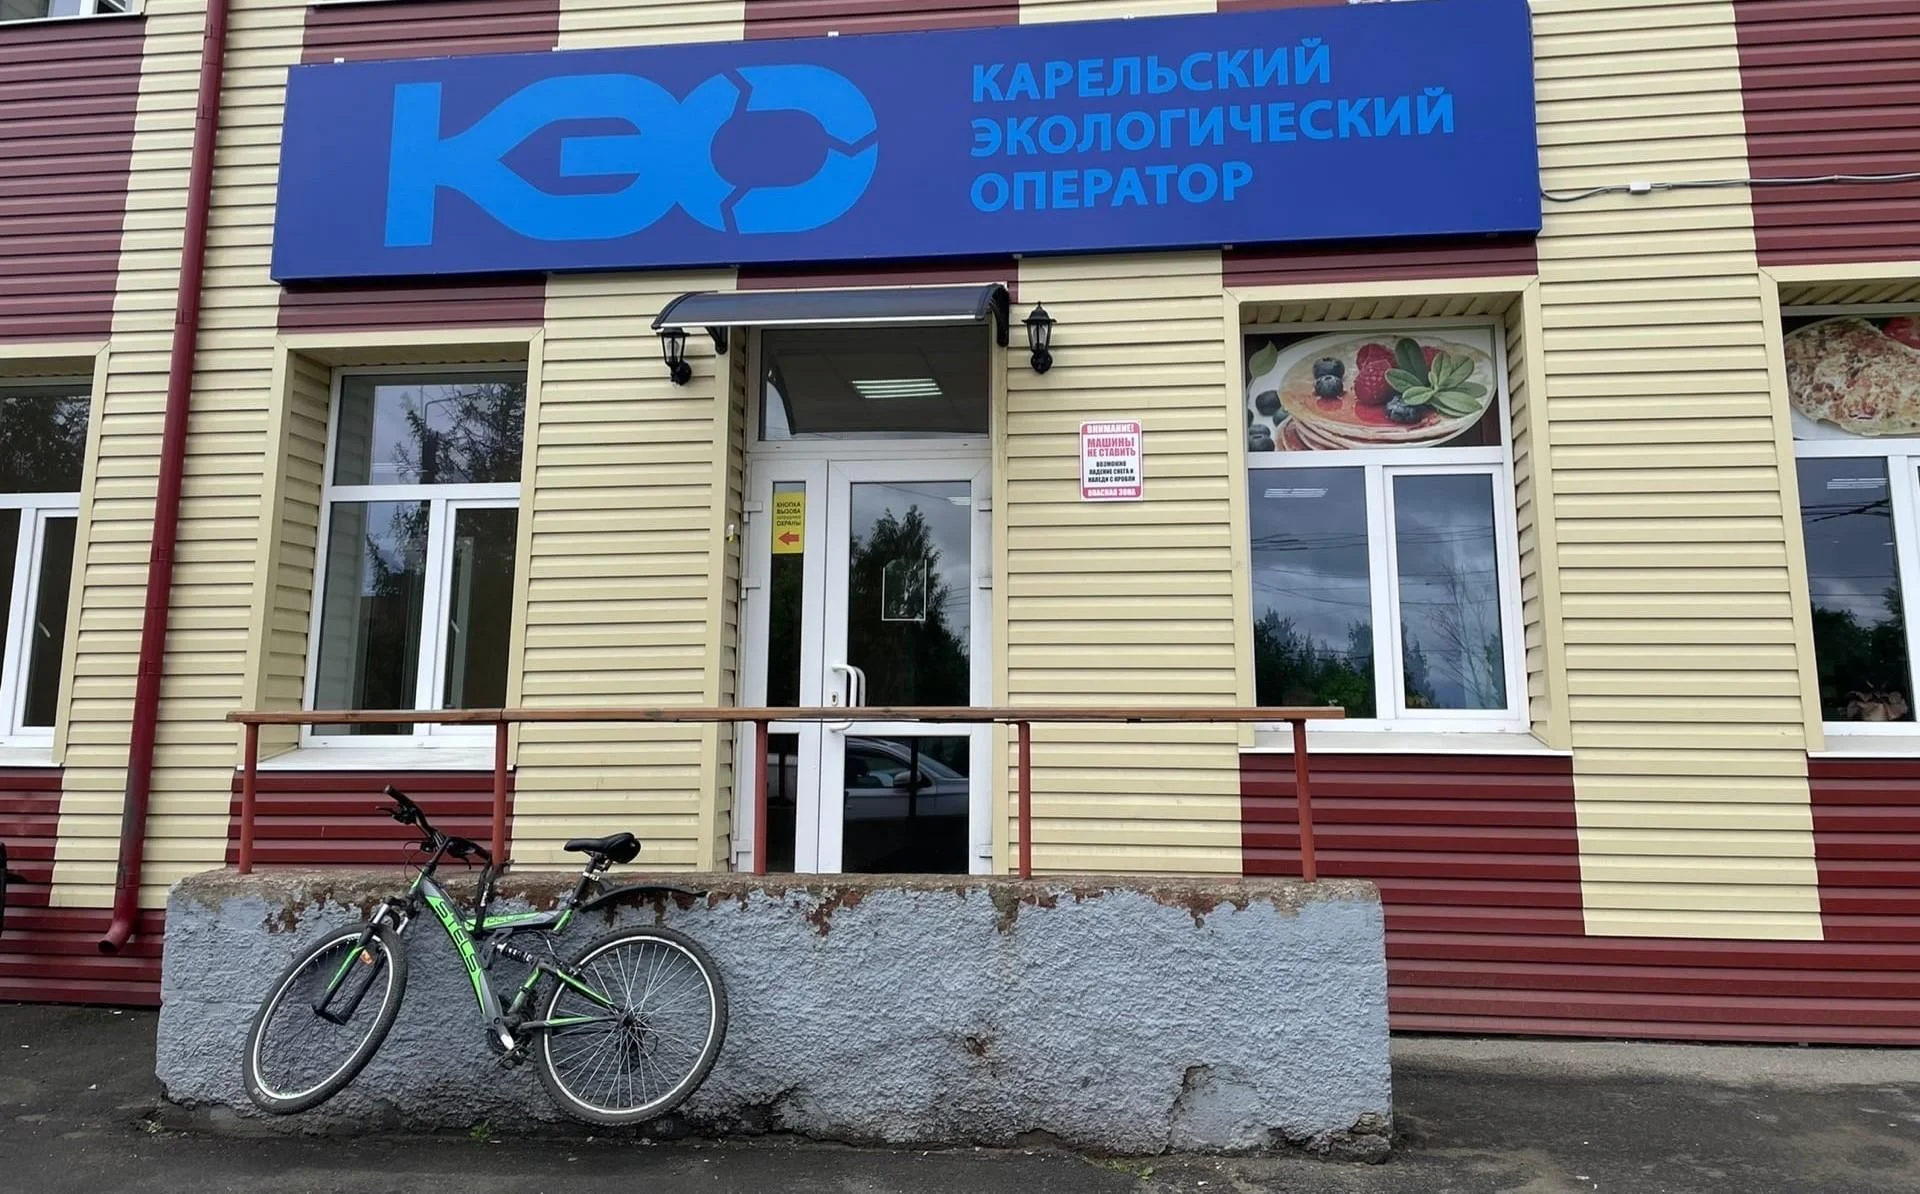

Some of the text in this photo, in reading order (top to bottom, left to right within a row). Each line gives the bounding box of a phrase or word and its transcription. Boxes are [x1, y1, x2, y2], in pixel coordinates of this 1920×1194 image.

[971, 37, 1331, 103] КАРЕЛЬСКИЙ
[970, 86, 1454, 157] ЭКОЛОГИЧЕСКИЙ
[384, 64, 879, 247] КЭО
[970, 161, 1253, 212] ОПЕРАТОР
[1087, 437, 1135, 448] МАШИНЫ
[1087, 448, 1136, 457] НЕ СТАВИТЬ
[1089, 468, 1112, 476] ПАДЕНИЕ
[435, 901, 477, 973] STELS
